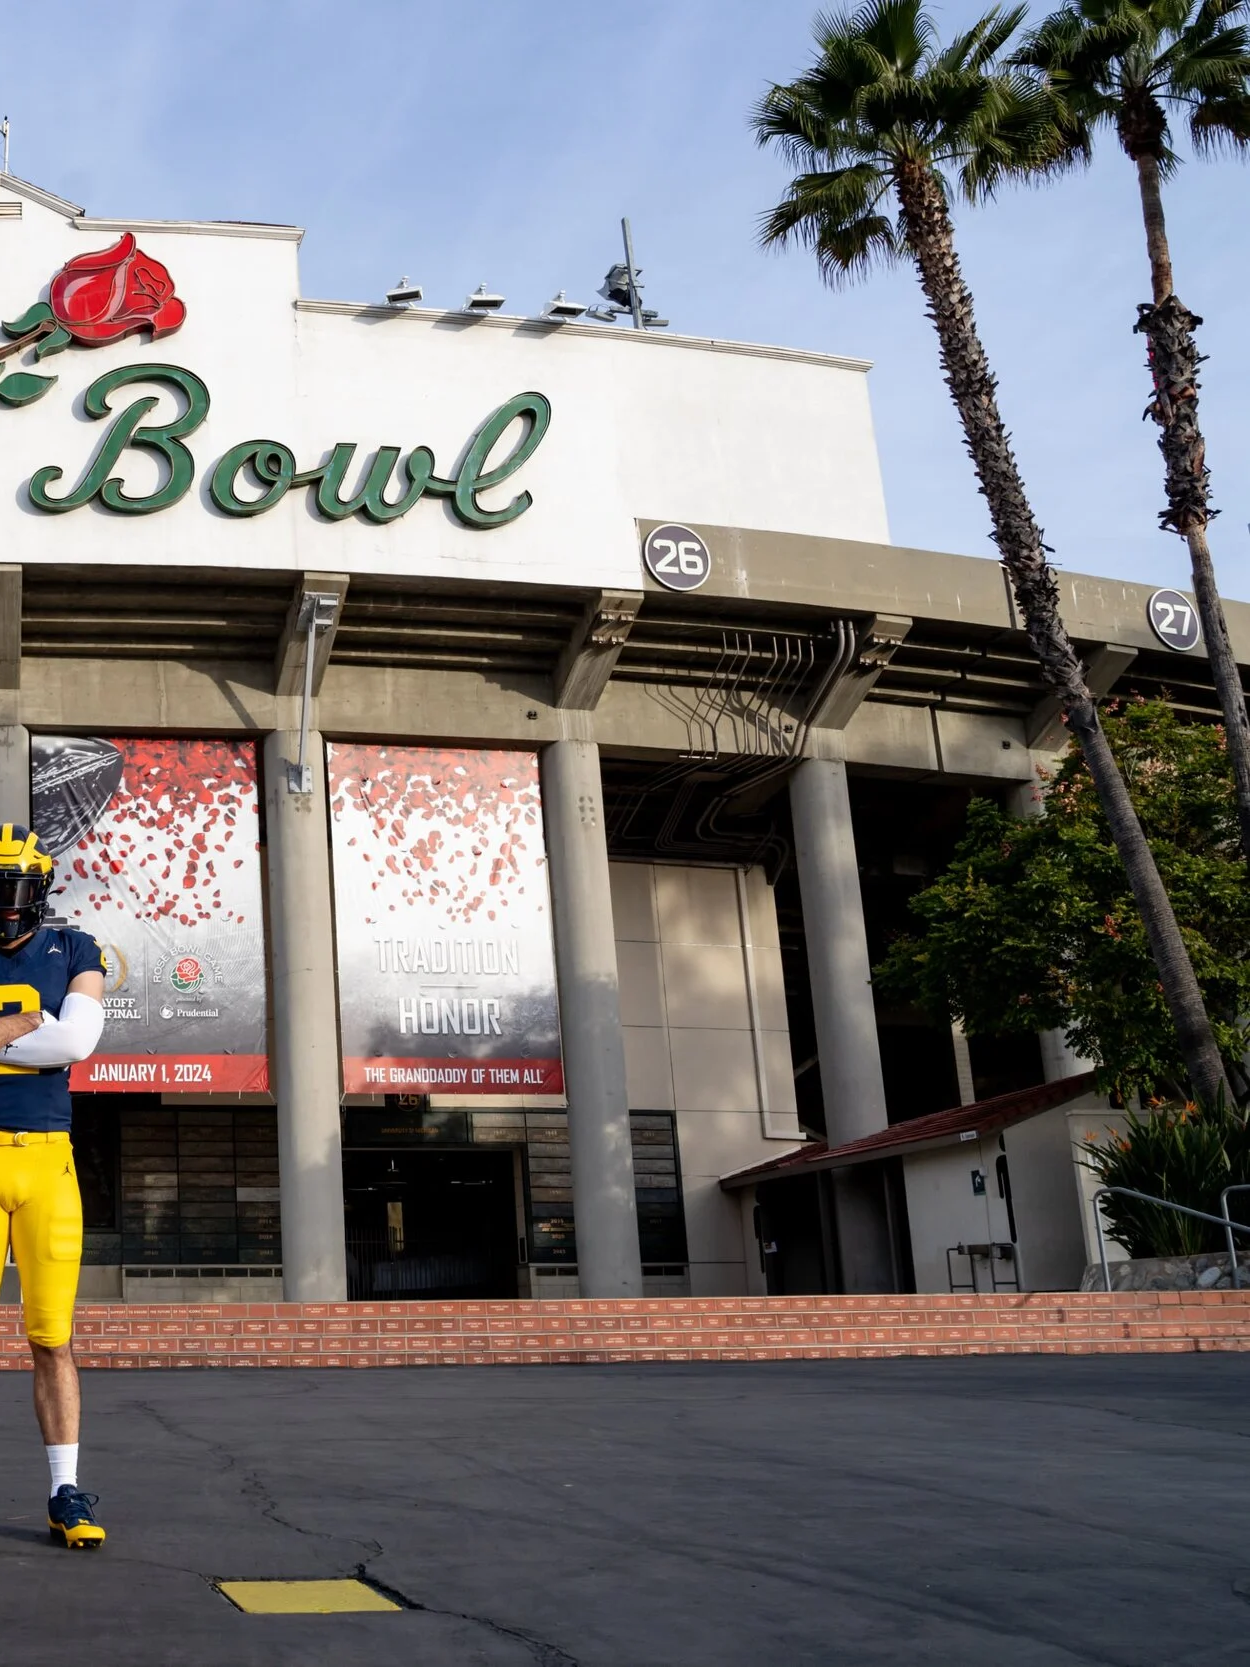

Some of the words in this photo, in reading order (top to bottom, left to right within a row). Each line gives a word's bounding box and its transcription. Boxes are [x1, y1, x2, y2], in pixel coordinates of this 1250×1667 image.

[29, 363, 551, 530] Bowl
[652, 539, 703, 576] 26
[1157, 604, 1191, 636] 27
[153, 954, 170, 983] ROSE
[169, 944, 203, 956] BOWL
[204, 952, 223, 983] GAME
[374, 937, 519, 975] TRADITION
[177, 1008, 218, 1018] Prudential
[399, 997, 502, 1035] HONOR
[90, 1063, 157, 1082] JANUARY
[161, 1064, 170, 1084] 1,
[174, 1064, 212, 1082] 2024
[364, 1067, 386, 1083] THE
[390, 1068, 468, 1084] GRANDDADDY
[472, 1068, 486, 1084] OF
[489, 1068, 520, 1084] THEM
